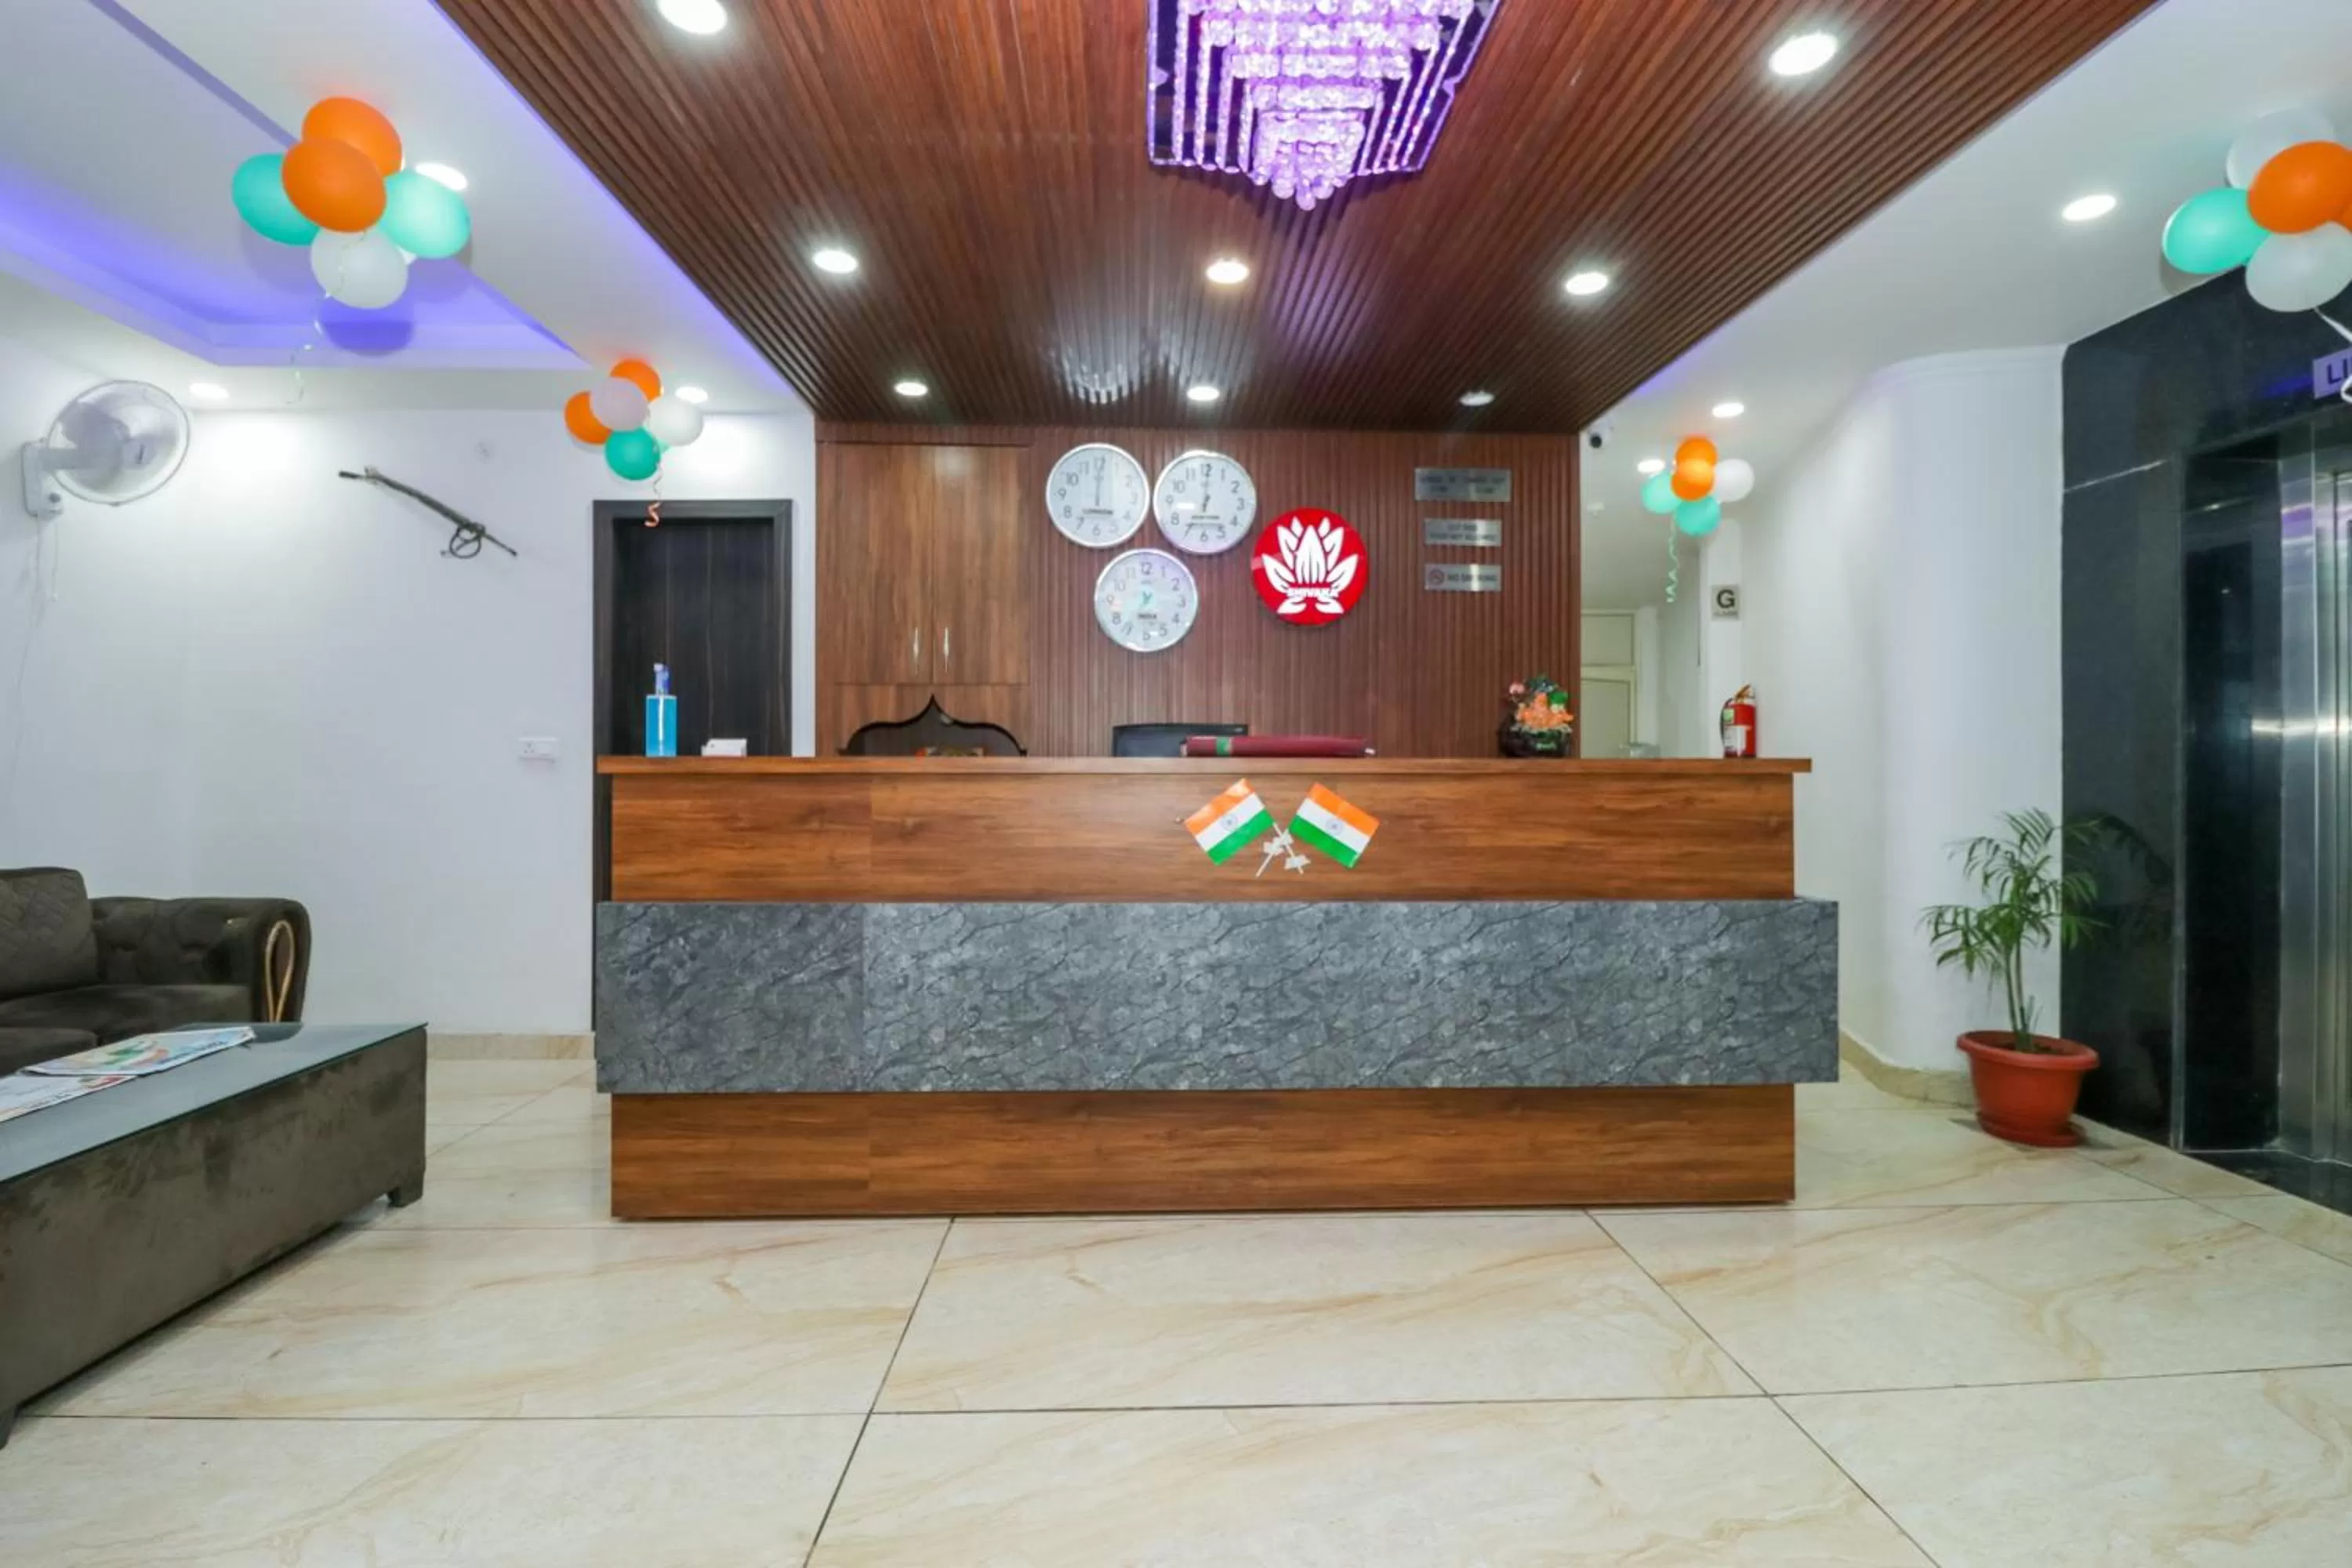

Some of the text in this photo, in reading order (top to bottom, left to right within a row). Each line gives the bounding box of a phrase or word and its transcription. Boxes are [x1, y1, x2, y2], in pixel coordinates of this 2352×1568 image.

[2327, 357, 2352, 384] LI
[1231, 480, 1240, 494] 2
[1236, 497, 1245, 511] 3
[1063, 505, 1073, 518] 8
[1171, 513, 1179, 525] 8
[1229, 516, 1238, 528] 4
[1092, 524, 1101, 536] 6
[1200, 529, 1208, 543] 6
[1171, 577, 1179, 591] 2
[1178, 594, 1186, 608] 3
[1716, 589, 1735, 609] G
[1112, 612, 1121, 625] 8
[1171, 612, 1180, 623] 4
[1159, 622, 1167, 637] 5
